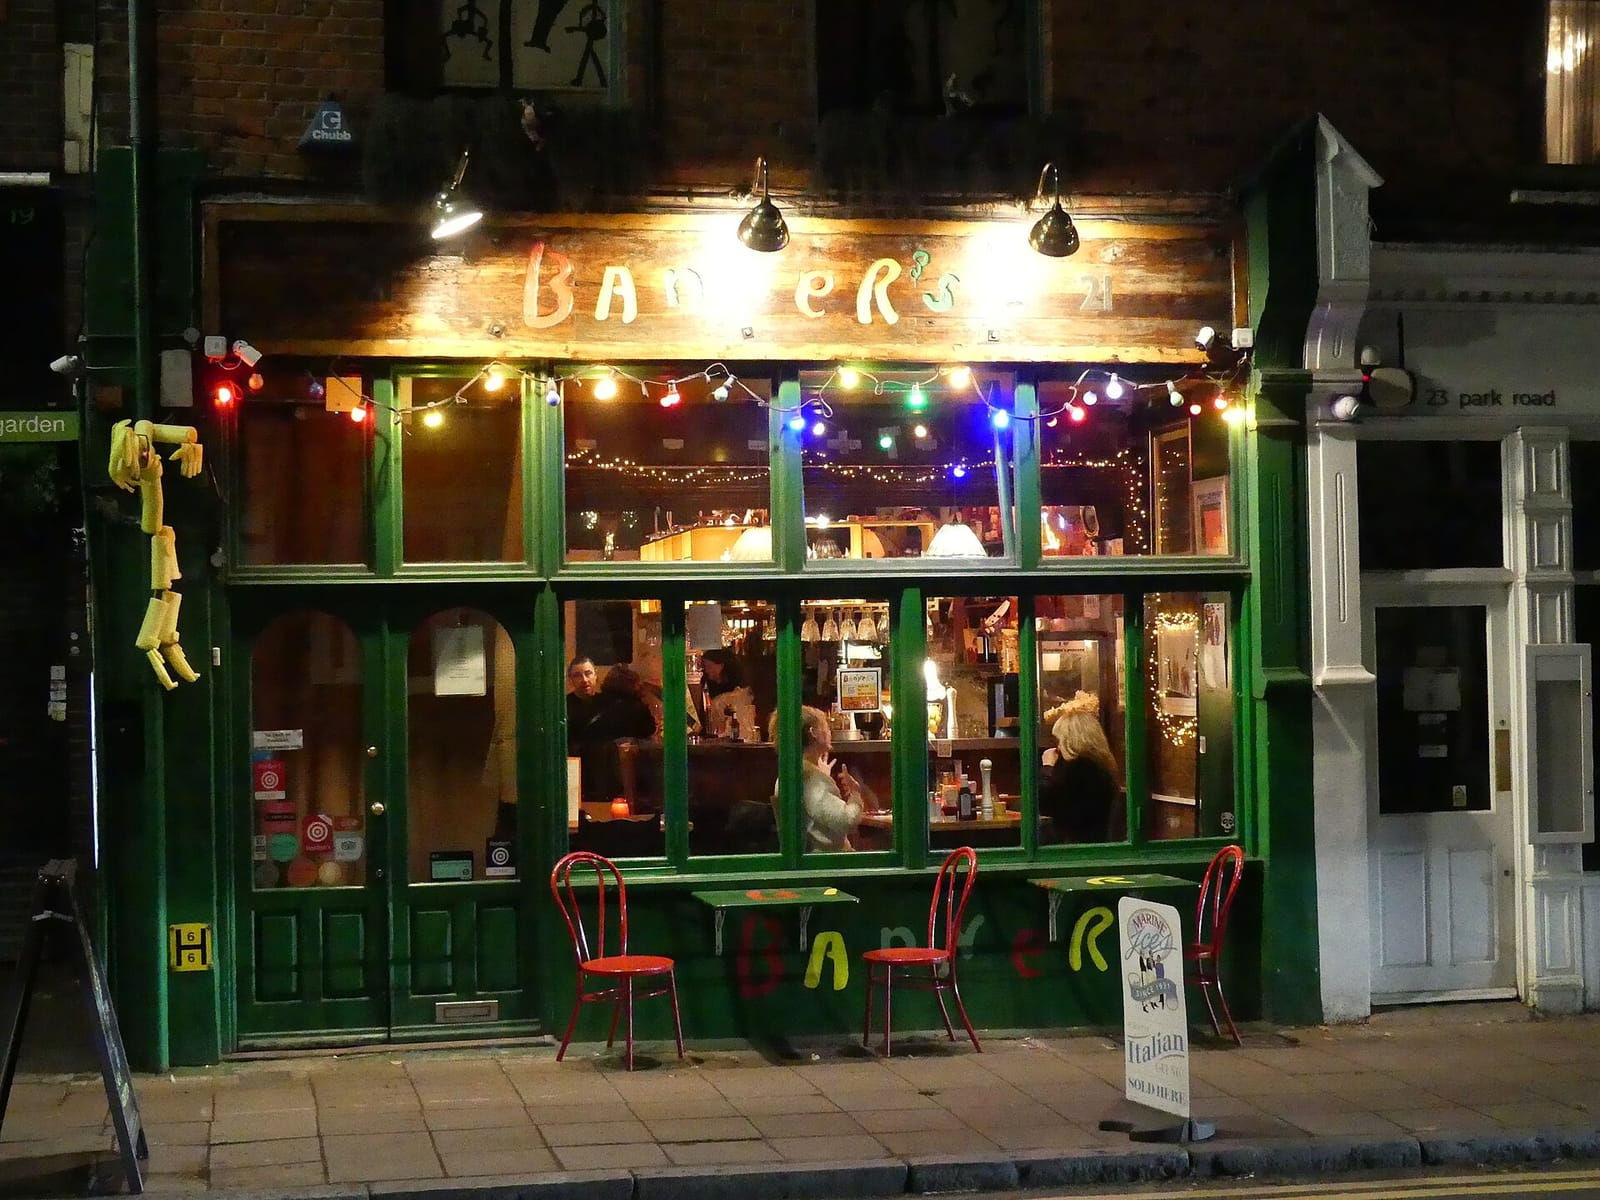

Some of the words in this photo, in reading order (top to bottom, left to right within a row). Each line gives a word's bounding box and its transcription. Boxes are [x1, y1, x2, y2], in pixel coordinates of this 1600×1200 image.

[312, 129, 352, 141] Chubb
[1079, 274, 1113, 312] 21
[1425, 388, 1449, 406] 23
[1459, 388, 1503, 409] park
[1512, 389, 1556, 406] road
[1132, 913, 1169, 935] MARINE
[175, 927, 207, 967] H
[186, 931, 196, 942] 6
[187, 952, 196, 963] 6
[1127, 1031, 1186, 1064] Italian
[1127, 1077, 1155, 1095] SOLD
[1156, 1085, 1187, 1105] HERE
